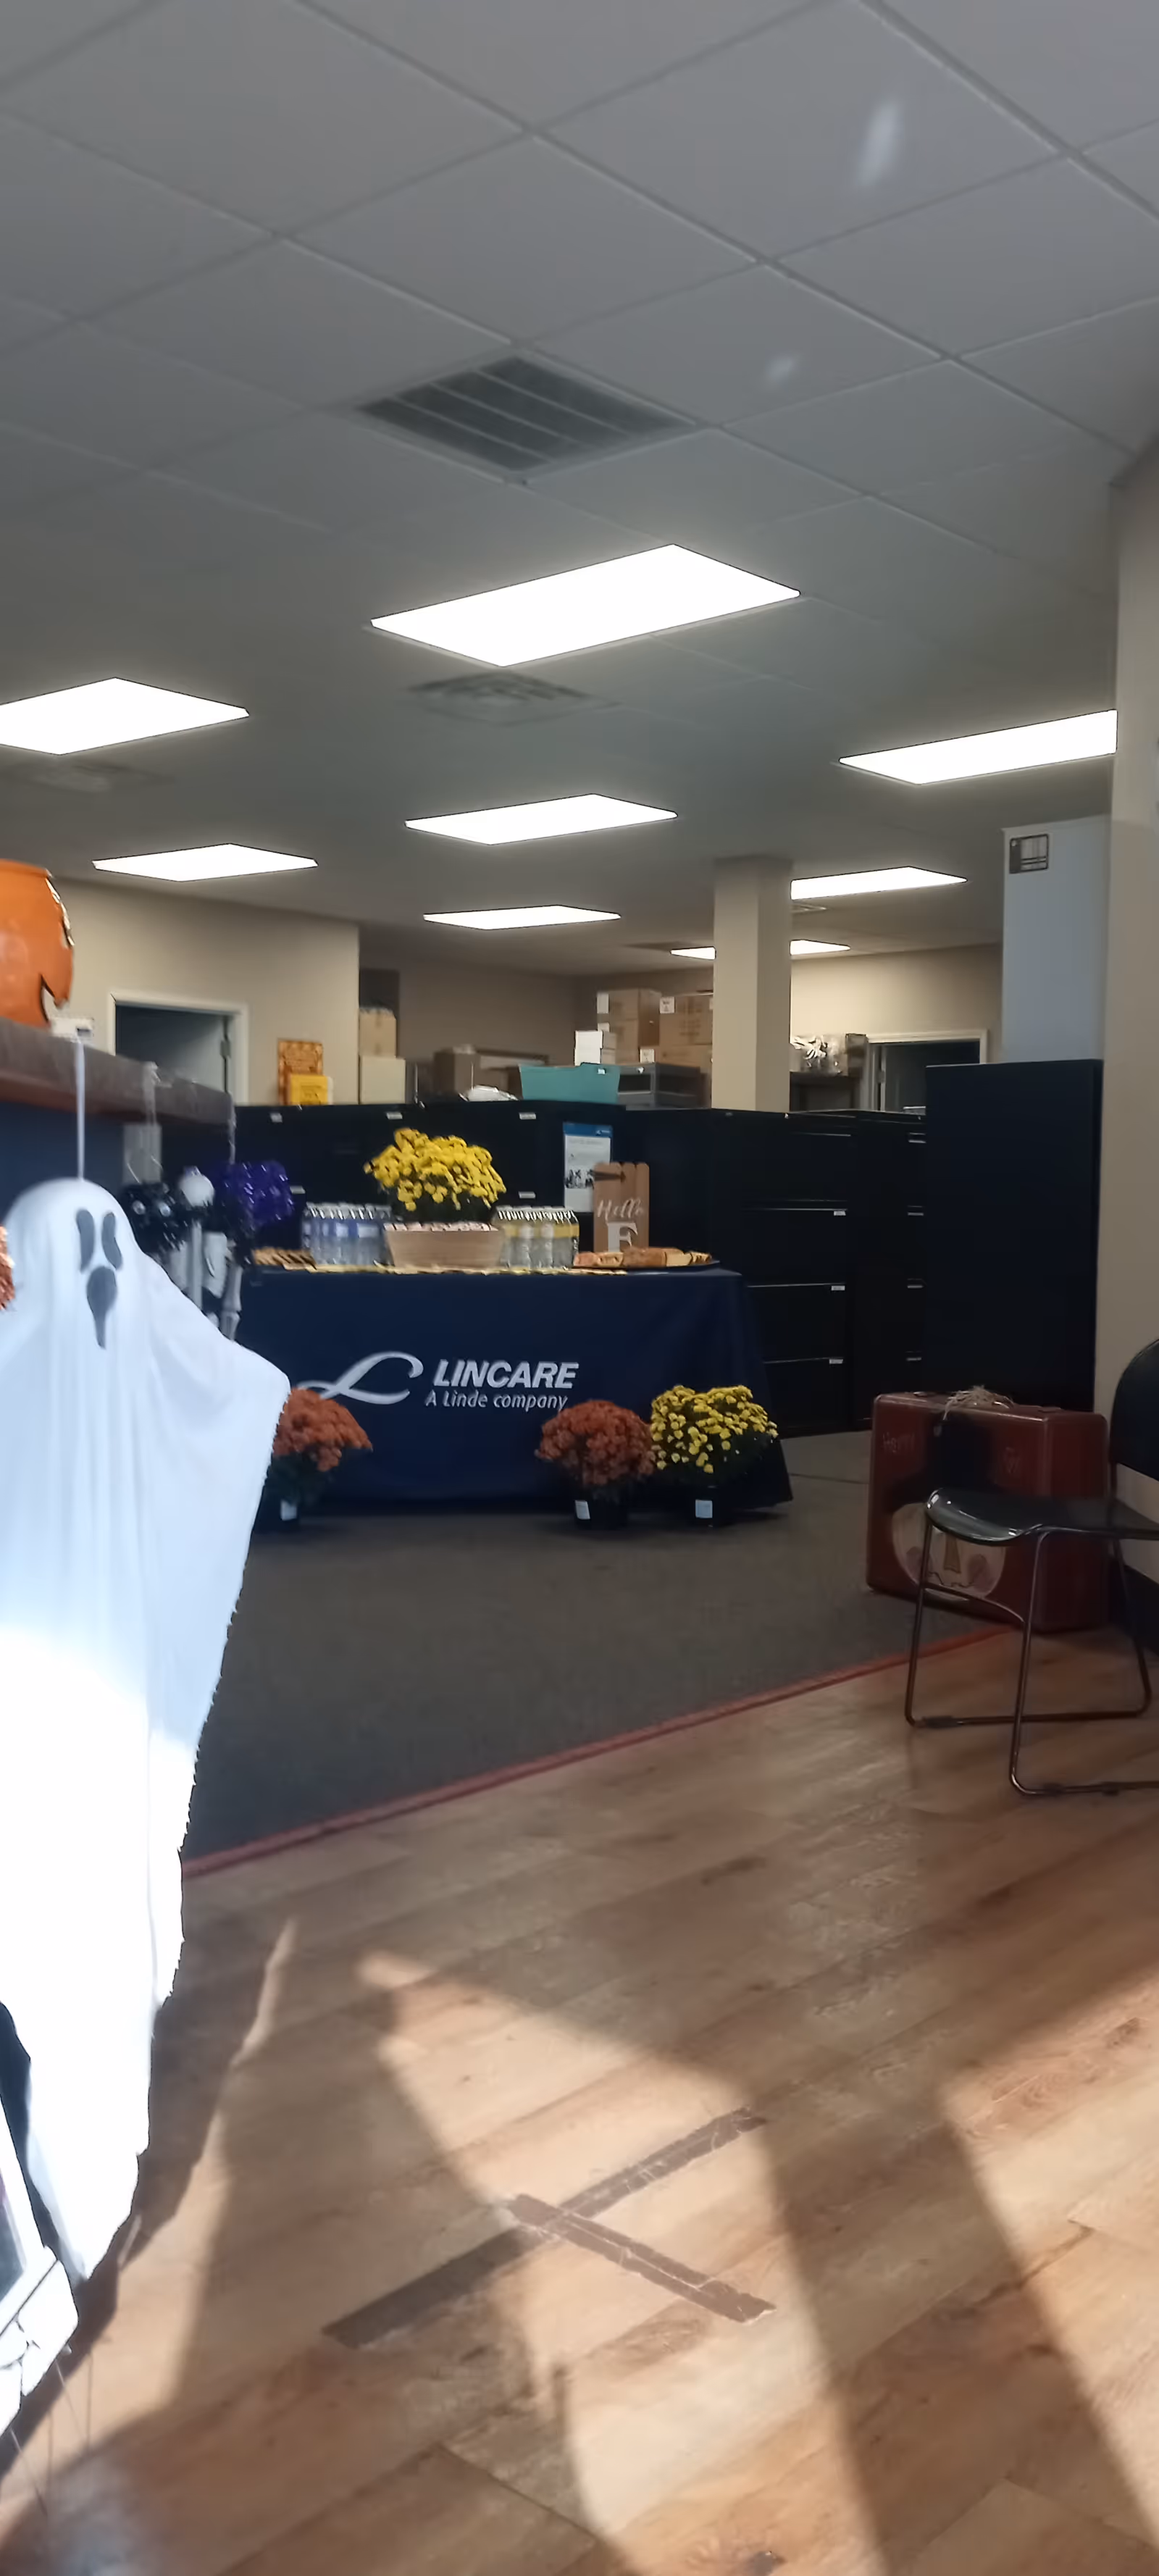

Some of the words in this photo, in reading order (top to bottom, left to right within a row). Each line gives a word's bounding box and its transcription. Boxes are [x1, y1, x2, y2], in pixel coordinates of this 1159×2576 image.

[597, 1197, 644, 1226] Hello
[433, 1358, 580, 1389] LINCARE
[425, 1389, 437, 1407] A
[443, 1389, 488, 1408] Linde
[493, 1394, 569, 1413] company
